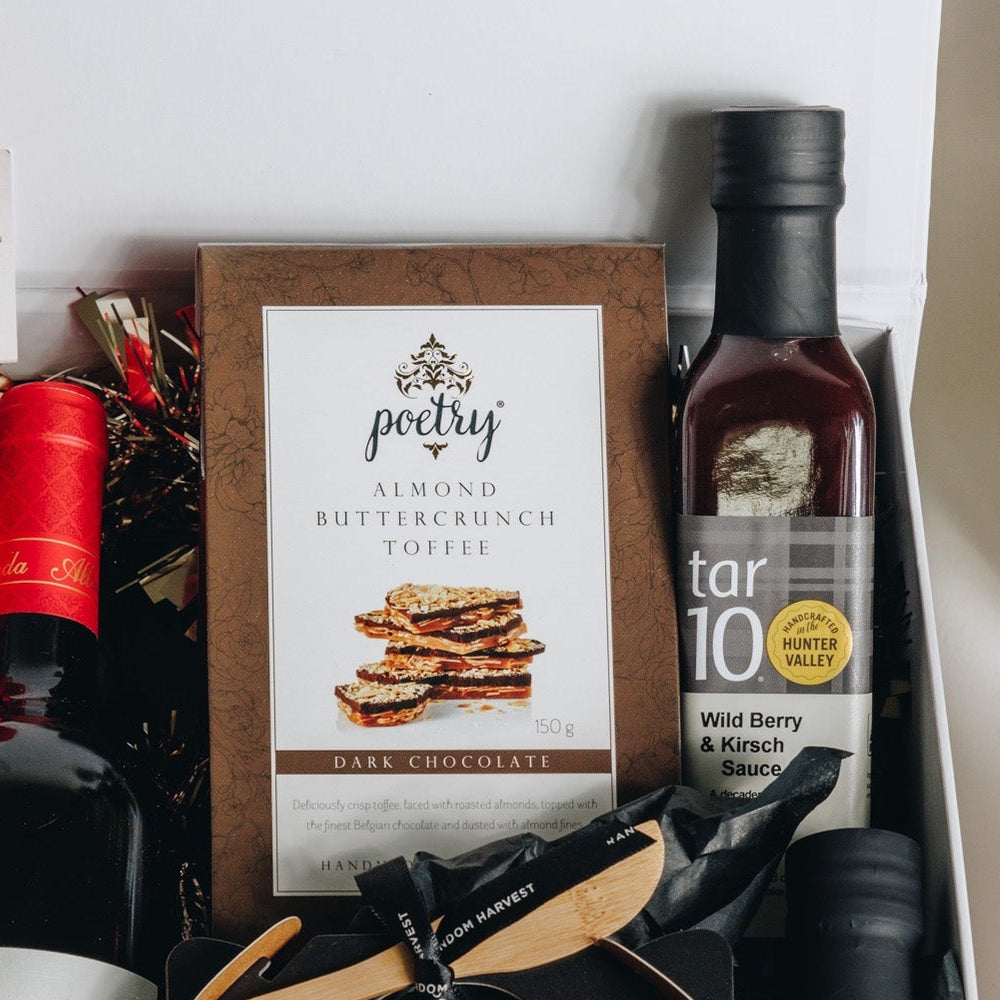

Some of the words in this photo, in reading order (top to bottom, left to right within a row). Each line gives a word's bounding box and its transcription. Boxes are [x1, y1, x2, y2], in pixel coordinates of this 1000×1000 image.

[373, 482, 496, 497] ALMOND
[316, 510, 555, 526] BUTTERCRUNCH
[383, 540, 489, 555] TOFFEE
[689, 551, 767, 598] tar
[783, 612, 839, 634] HANDCRAFTED
[783, 637, 837, 651] HUNTER
[785, 653, 834, 667] VALLEY
[534, 719, 561, 735] 150
[701, 712, 743, 728] Wild
[750, 713, 802, 732] Berry
[700, 738, 714, 752] &
[722, 737, 784, 753] Kirsch
[334, 756, 394, 769] DARK
[409, 755, 550, 769] CHOCOLATE
[722, 760, 781, 776] Sauce
[441, 821, 459, 830] and
